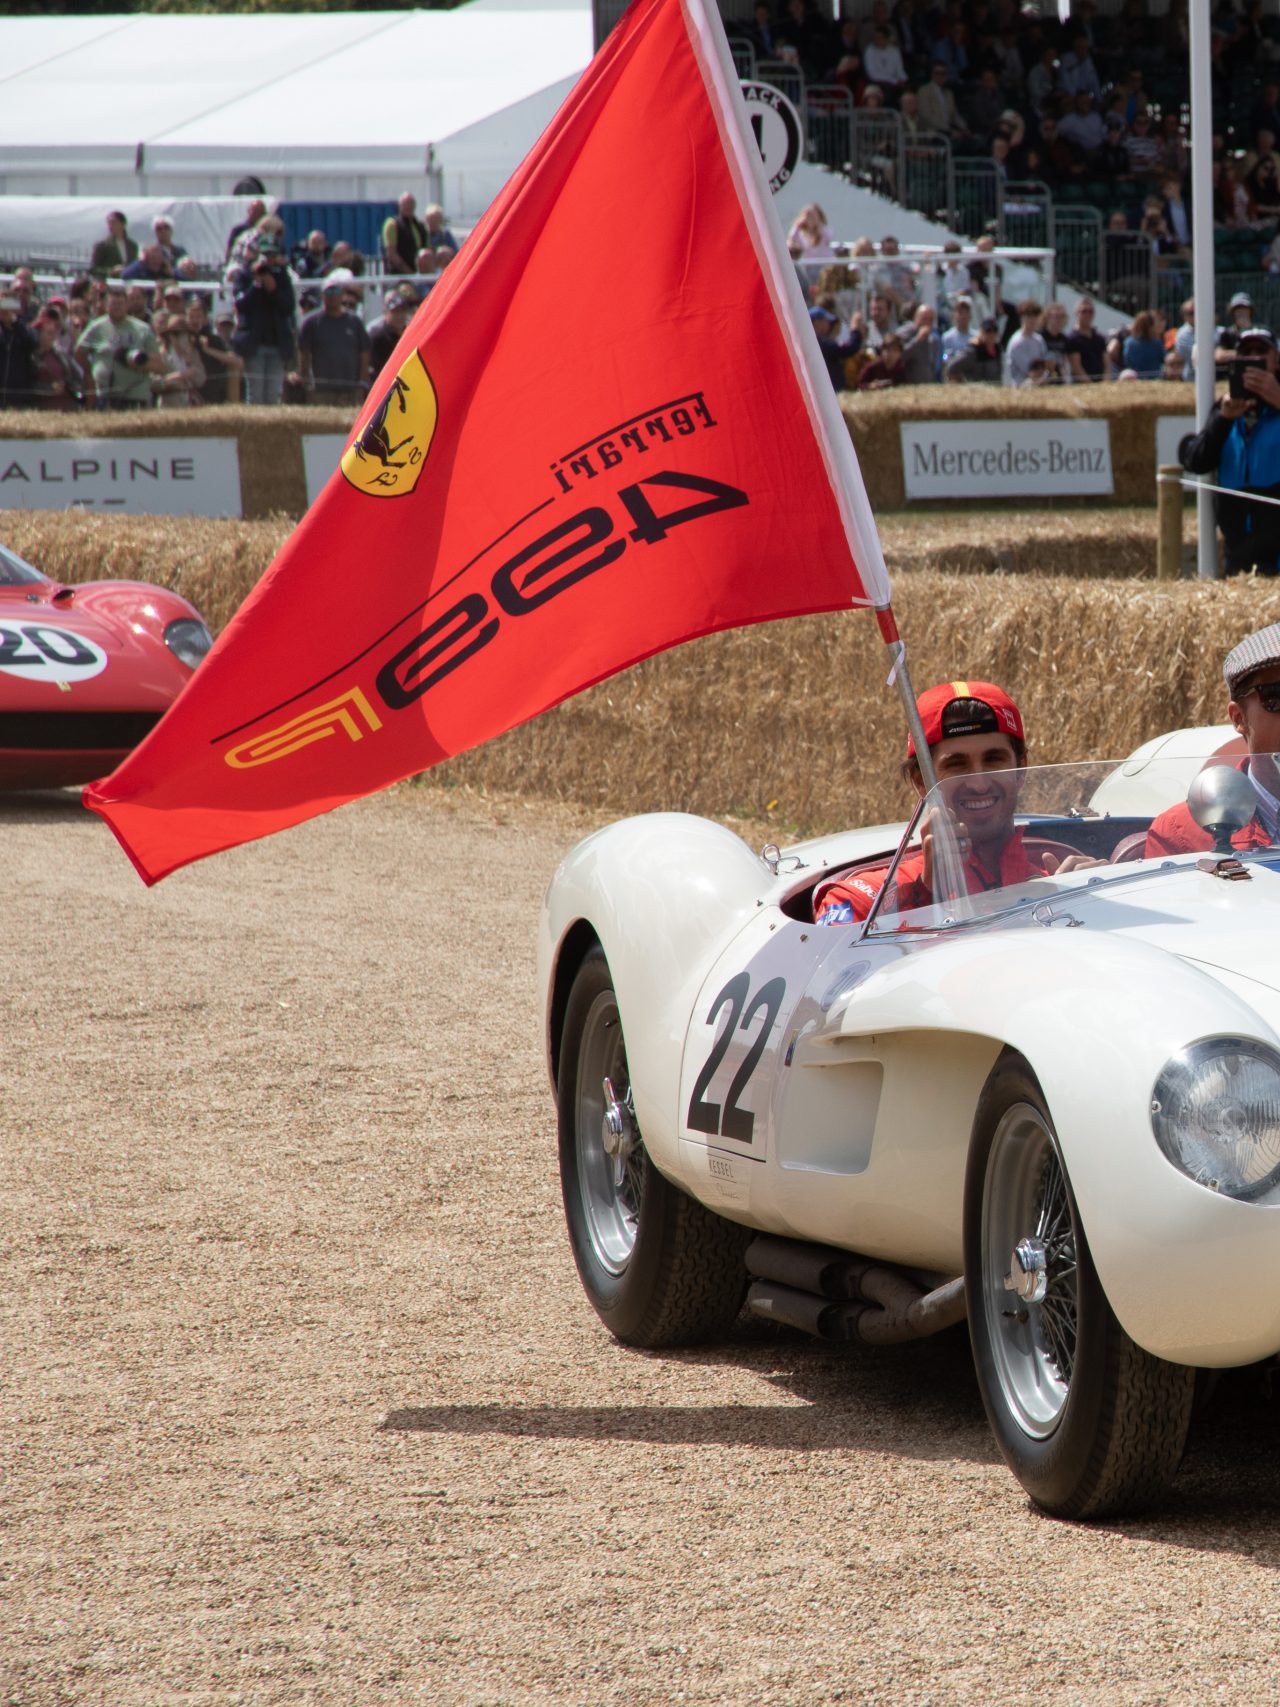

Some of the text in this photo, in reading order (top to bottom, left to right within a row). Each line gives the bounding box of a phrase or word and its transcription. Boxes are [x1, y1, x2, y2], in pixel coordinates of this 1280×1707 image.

[745, 86, 783, 111] ACK
[0, 458, 195, 482] ALPINE
[912, 439, 1105, 476] Mercedes-Benz
[687, 971, 786, 1144] 22
